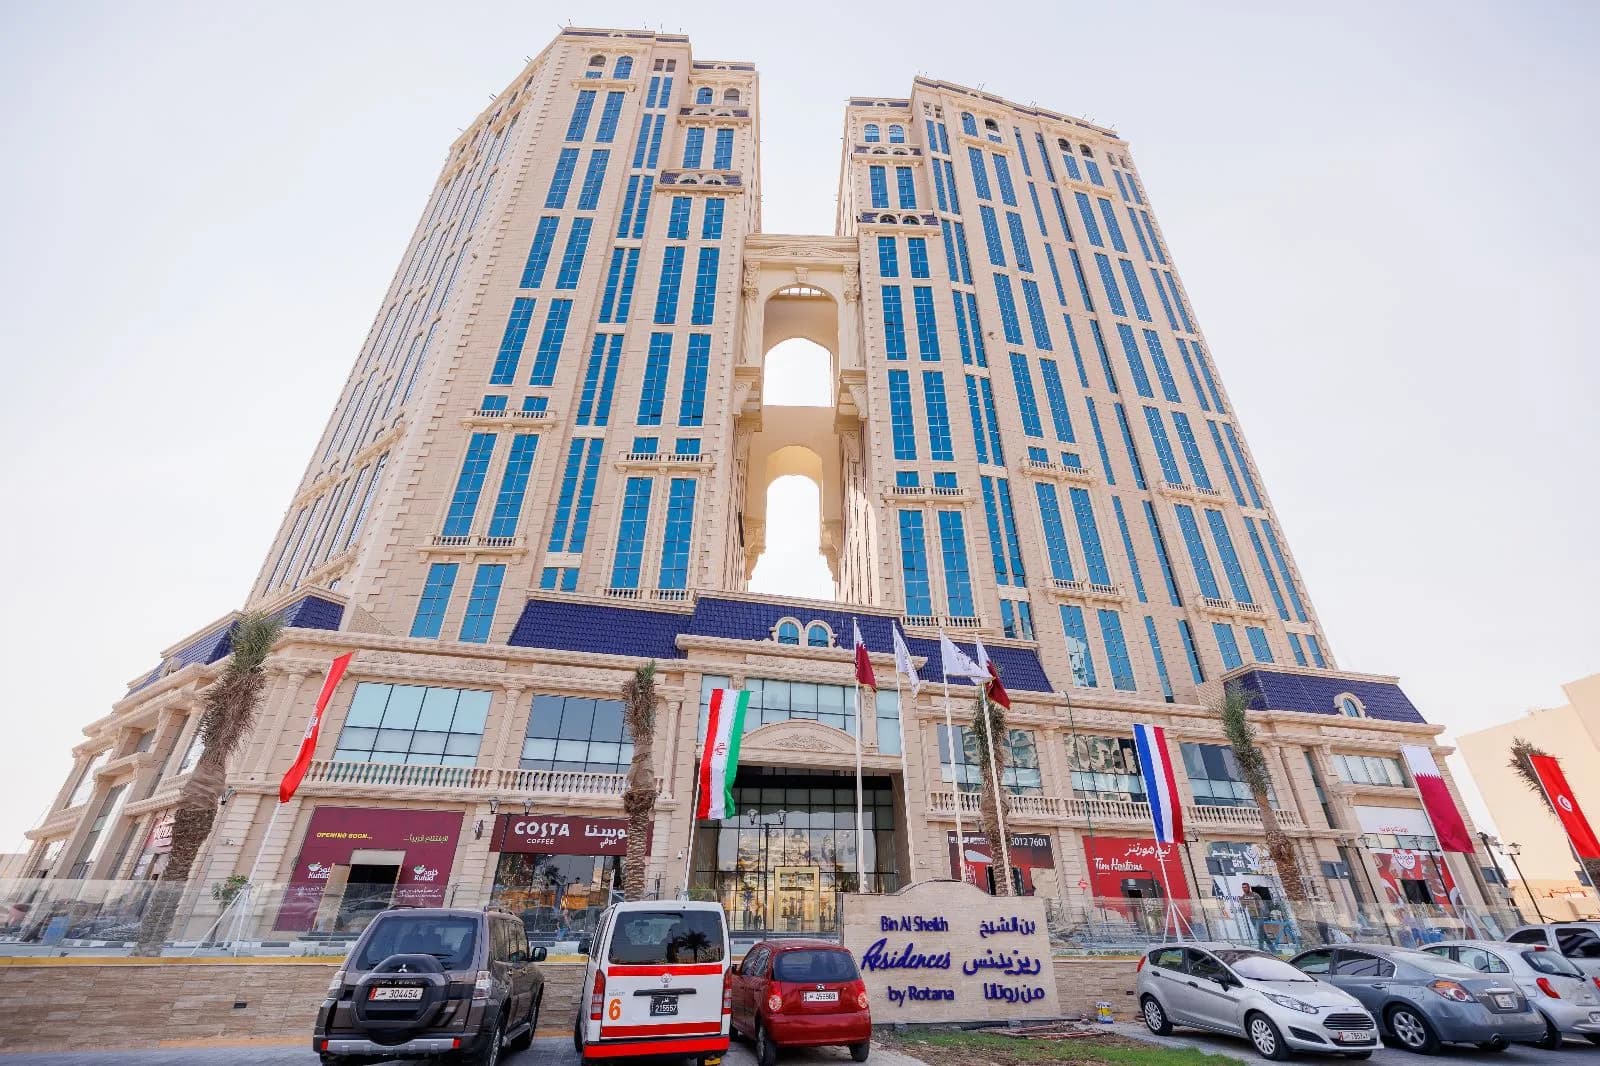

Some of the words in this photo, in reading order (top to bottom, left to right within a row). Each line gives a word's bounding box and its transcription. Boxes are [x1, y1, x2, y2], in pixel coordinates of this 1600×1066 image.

[515, 822, 570, 837] COSTA
[585, 824, 628, 839] وستا
[1030, 837, 1047, 847] 7601
[1093, 857, 1110, 871] Tim
[1110, 857, 1143, 871] Hortons
[881, 916, 899, 932] Bin
[900, 916, 912, 932] Al
[913, 916, 949, 932] Sheikh
[979, 916, 1018, 939] الشيخ
[1019, 918, 1036, 936] بن
[861, 937, 951, 972] Residences
[963, 949, 1041, 976] ريزيدنس
[389, 989, 418, 999] 304454
[887, 985, 906, 1007] by
[908, 985, 955, 1001] Rotana
[983, 983, 1020, 1004] روتانا
[1020, 984, 1046, 1004] من
[608, 998, 623, 1021] 6
